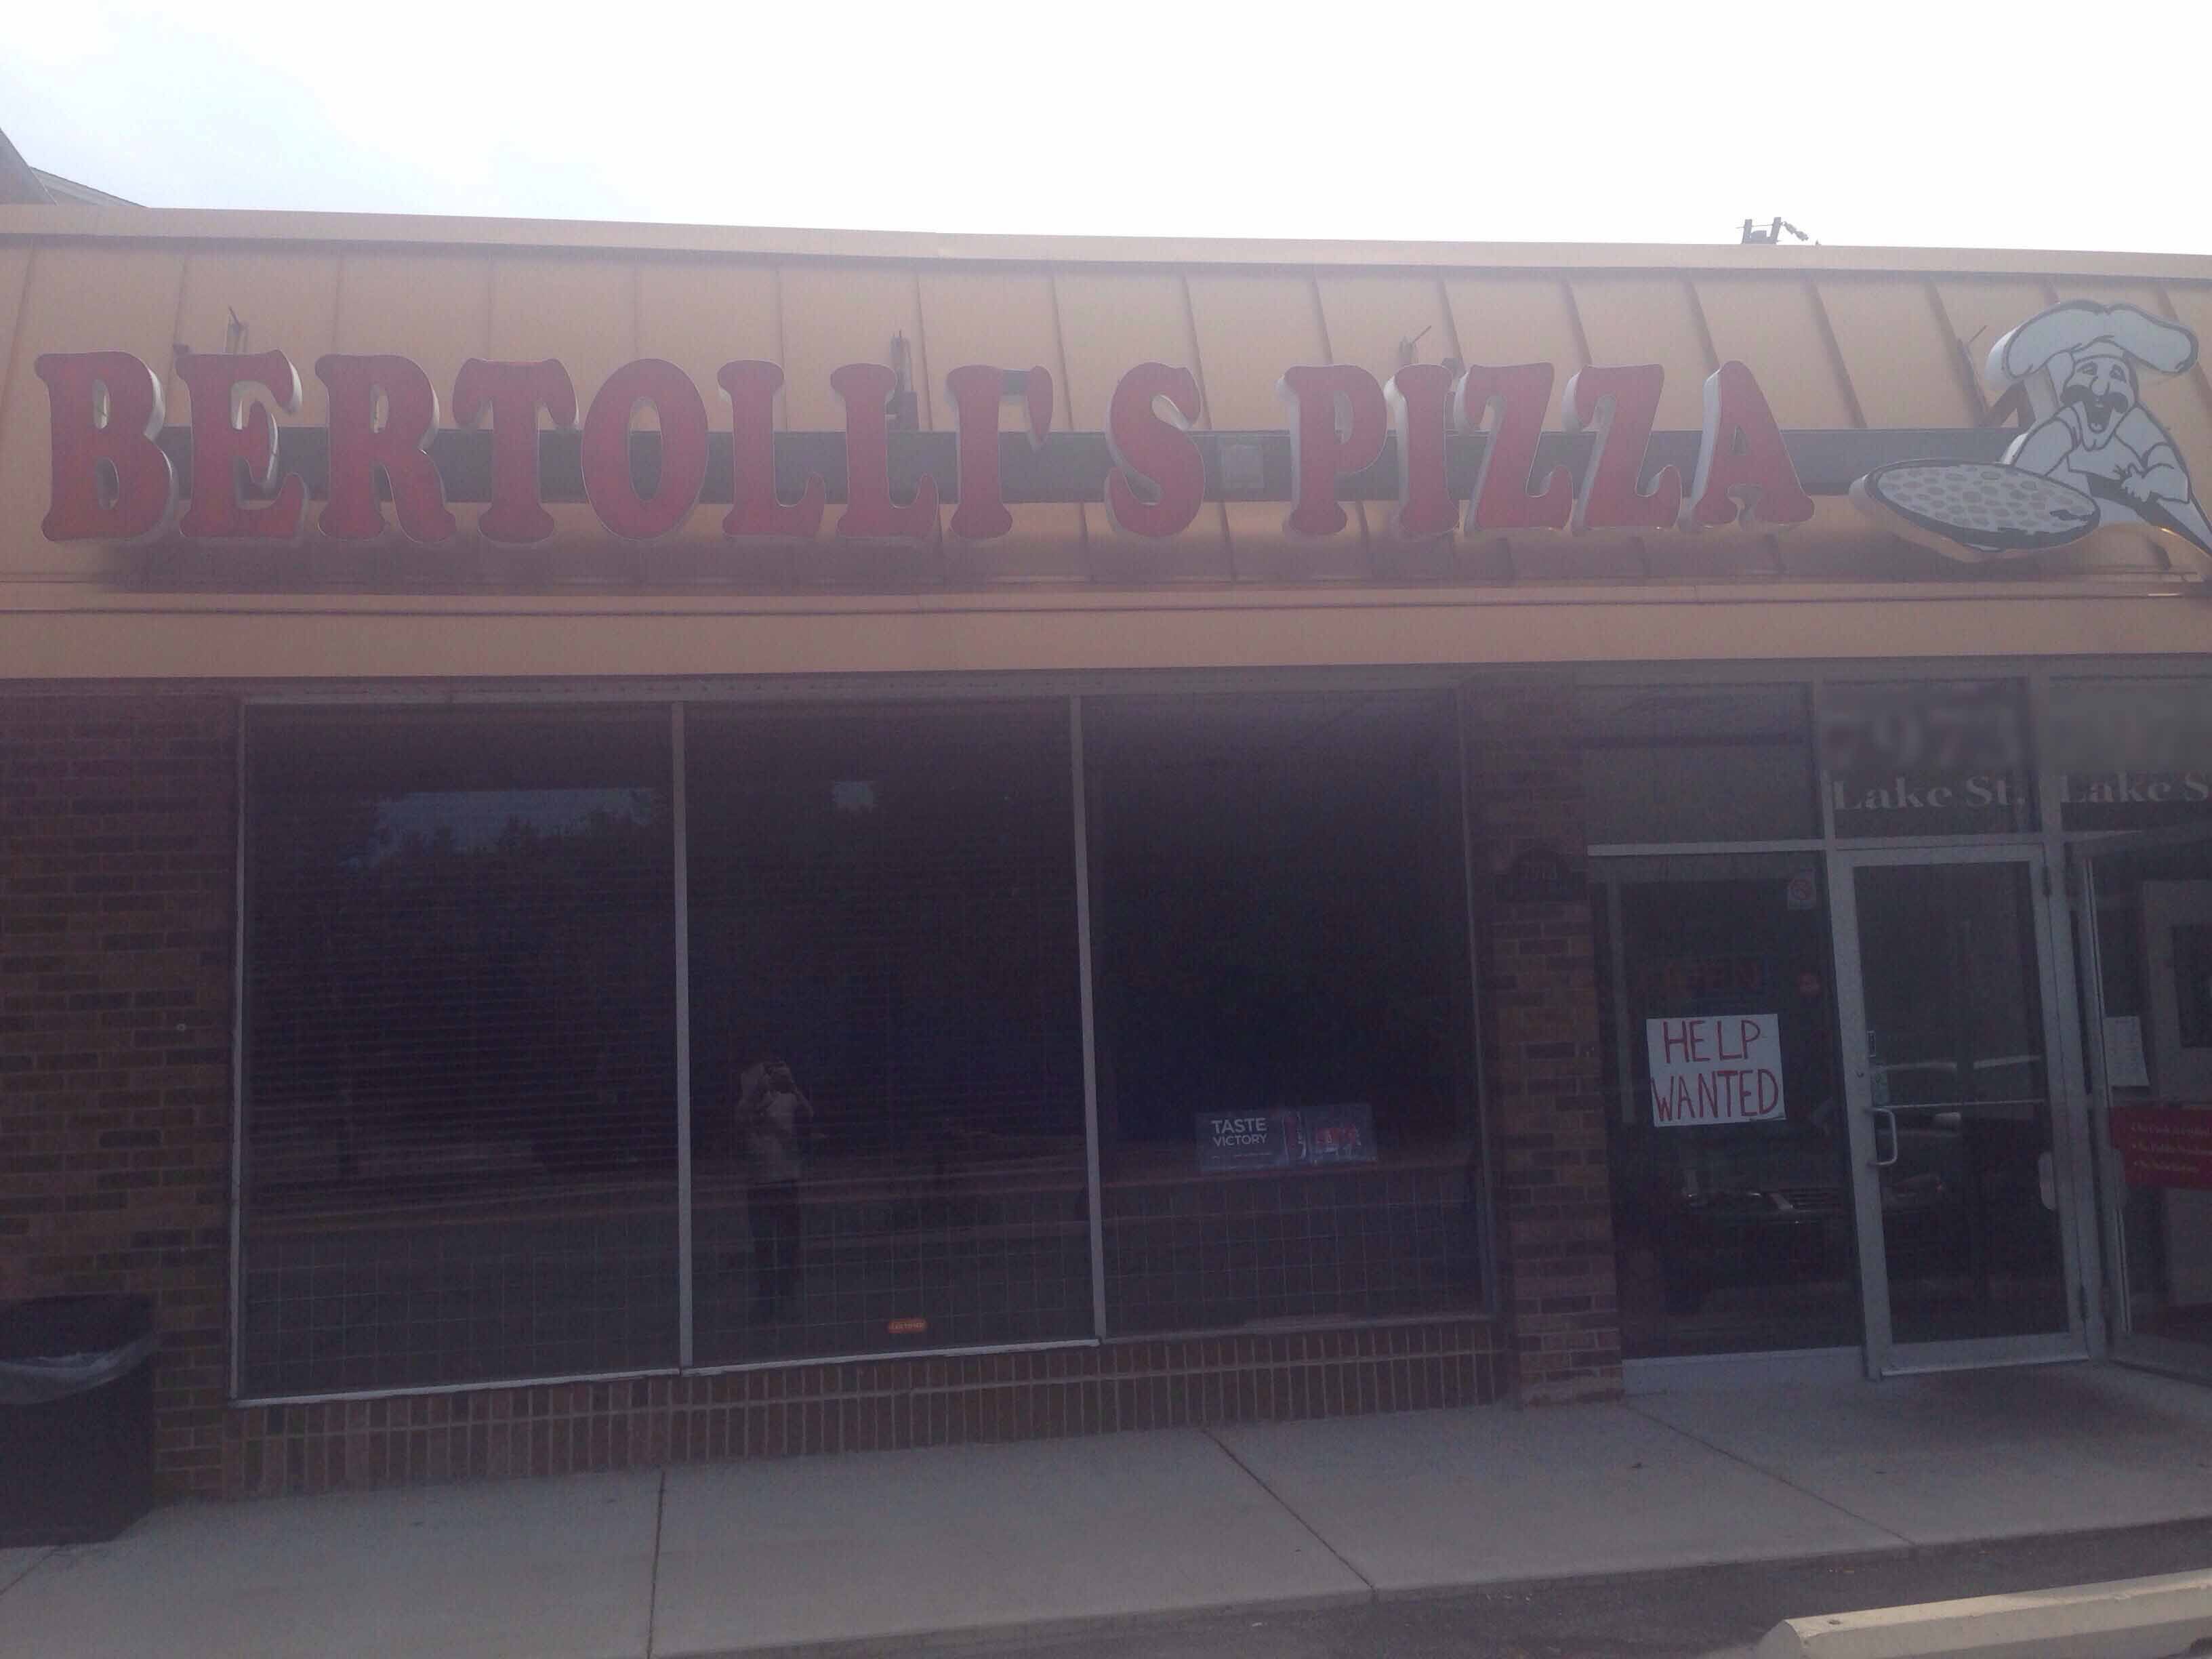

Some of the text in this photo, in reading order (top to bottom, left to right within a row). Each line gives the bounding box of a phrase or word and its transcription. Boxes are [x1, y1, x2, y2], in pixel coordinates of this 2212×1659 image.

[34, 349, 1816, 542] BERTOLLI'S PIZZA
[1832, 776, 1952, 808] Lake
[1662, 1019, 1761, 1063] HELP
[1648, 1067, 1780, 1121] WANTED
[1210, 1116, 1269, 1134] TASTE
[1211, 1132, 1269, 1149] VICTORY
